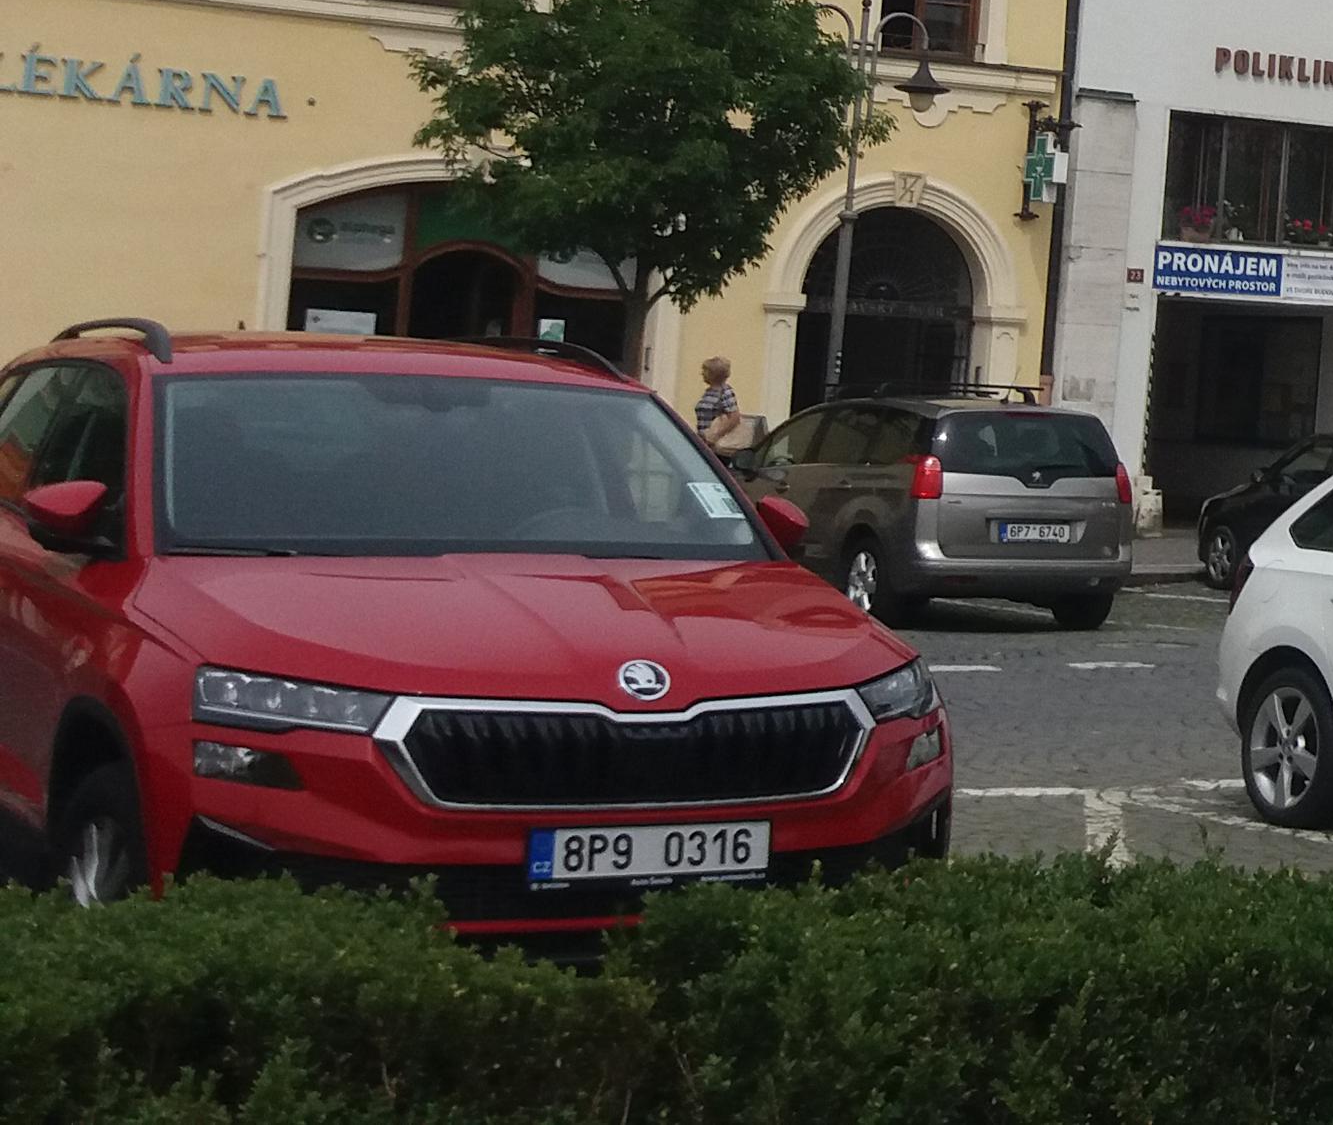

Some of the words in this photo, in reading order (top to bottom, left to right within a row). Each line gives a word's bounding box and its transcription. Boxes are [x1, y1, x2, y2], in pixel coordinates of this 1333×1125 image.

[1157, 251, 1277, 277] PRONÁJEM
[1156, 275, 1226, 290] NEBYTOVÝCH
[1228, 280, 1276, 292] PROSTOR
[1009, 525, 1031, 538] 6P7
[1039, 525, 1066, 539] 6740
[562, 834, 634, 873] 8P9
[663, 828, 754, 869] 0316
[532, 861, 552, 874] CZ
